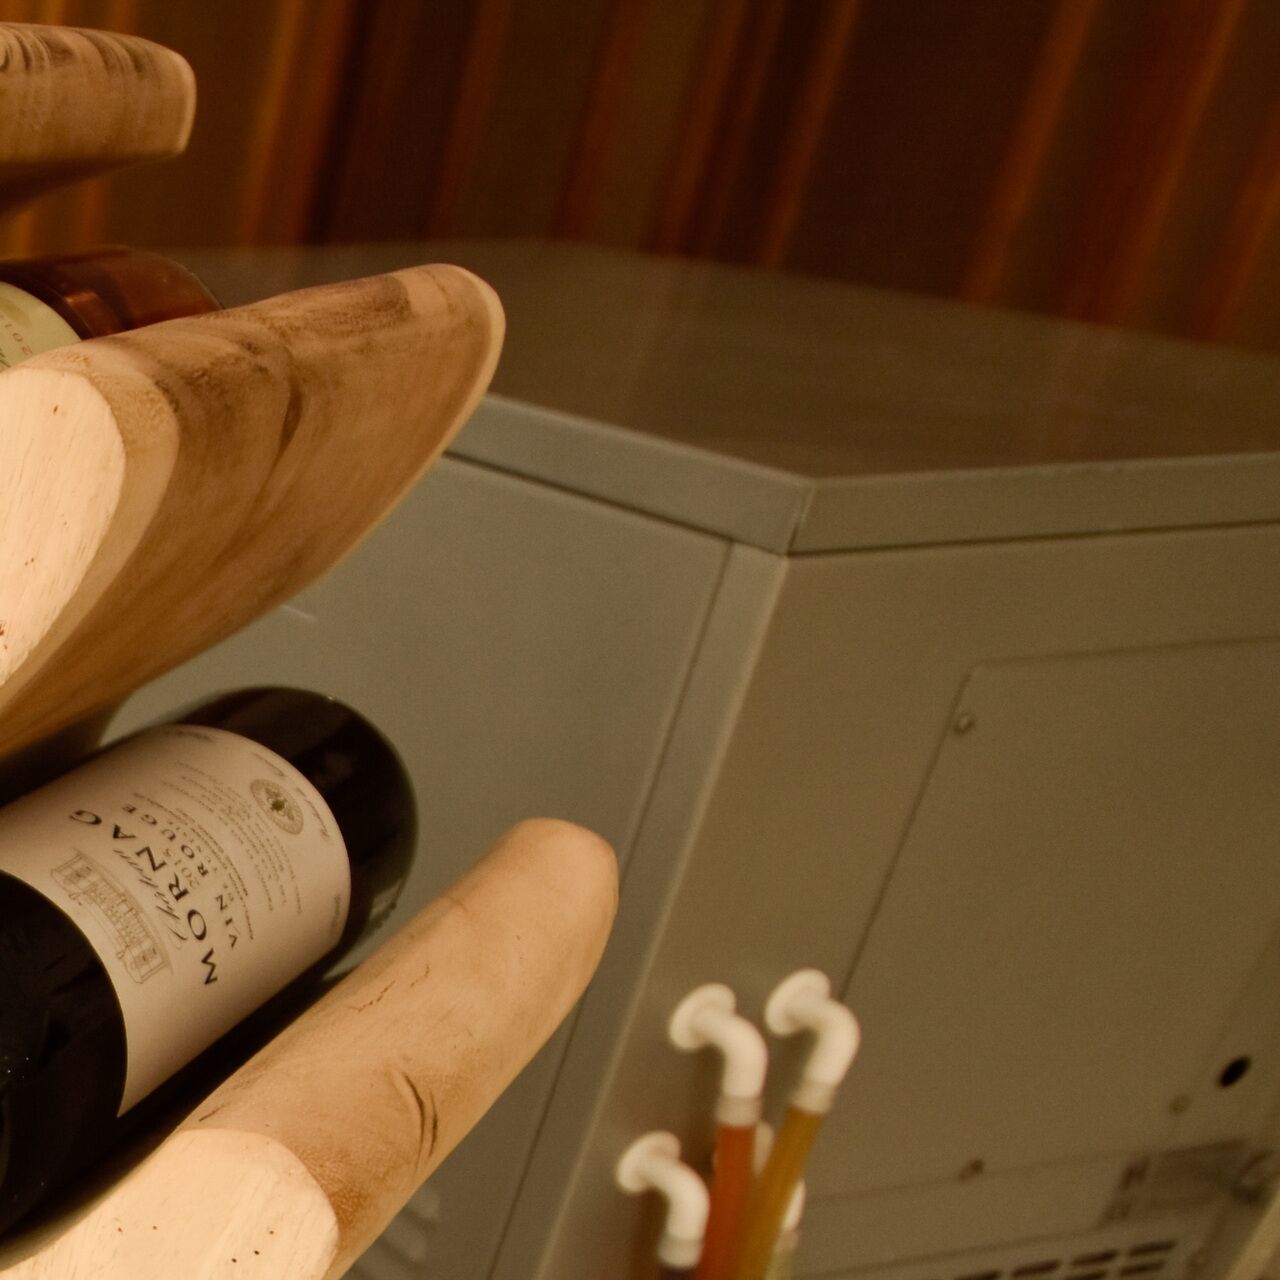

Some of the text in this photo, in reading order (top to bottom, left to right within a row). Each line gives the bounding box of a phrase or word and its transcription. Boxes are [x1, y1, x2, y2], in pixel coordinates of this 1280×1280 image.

[122, 802, 209, 879] ROUGE
[69, 809, 219, 986] MORNAG
[215, 893, 239, 949] VIN
